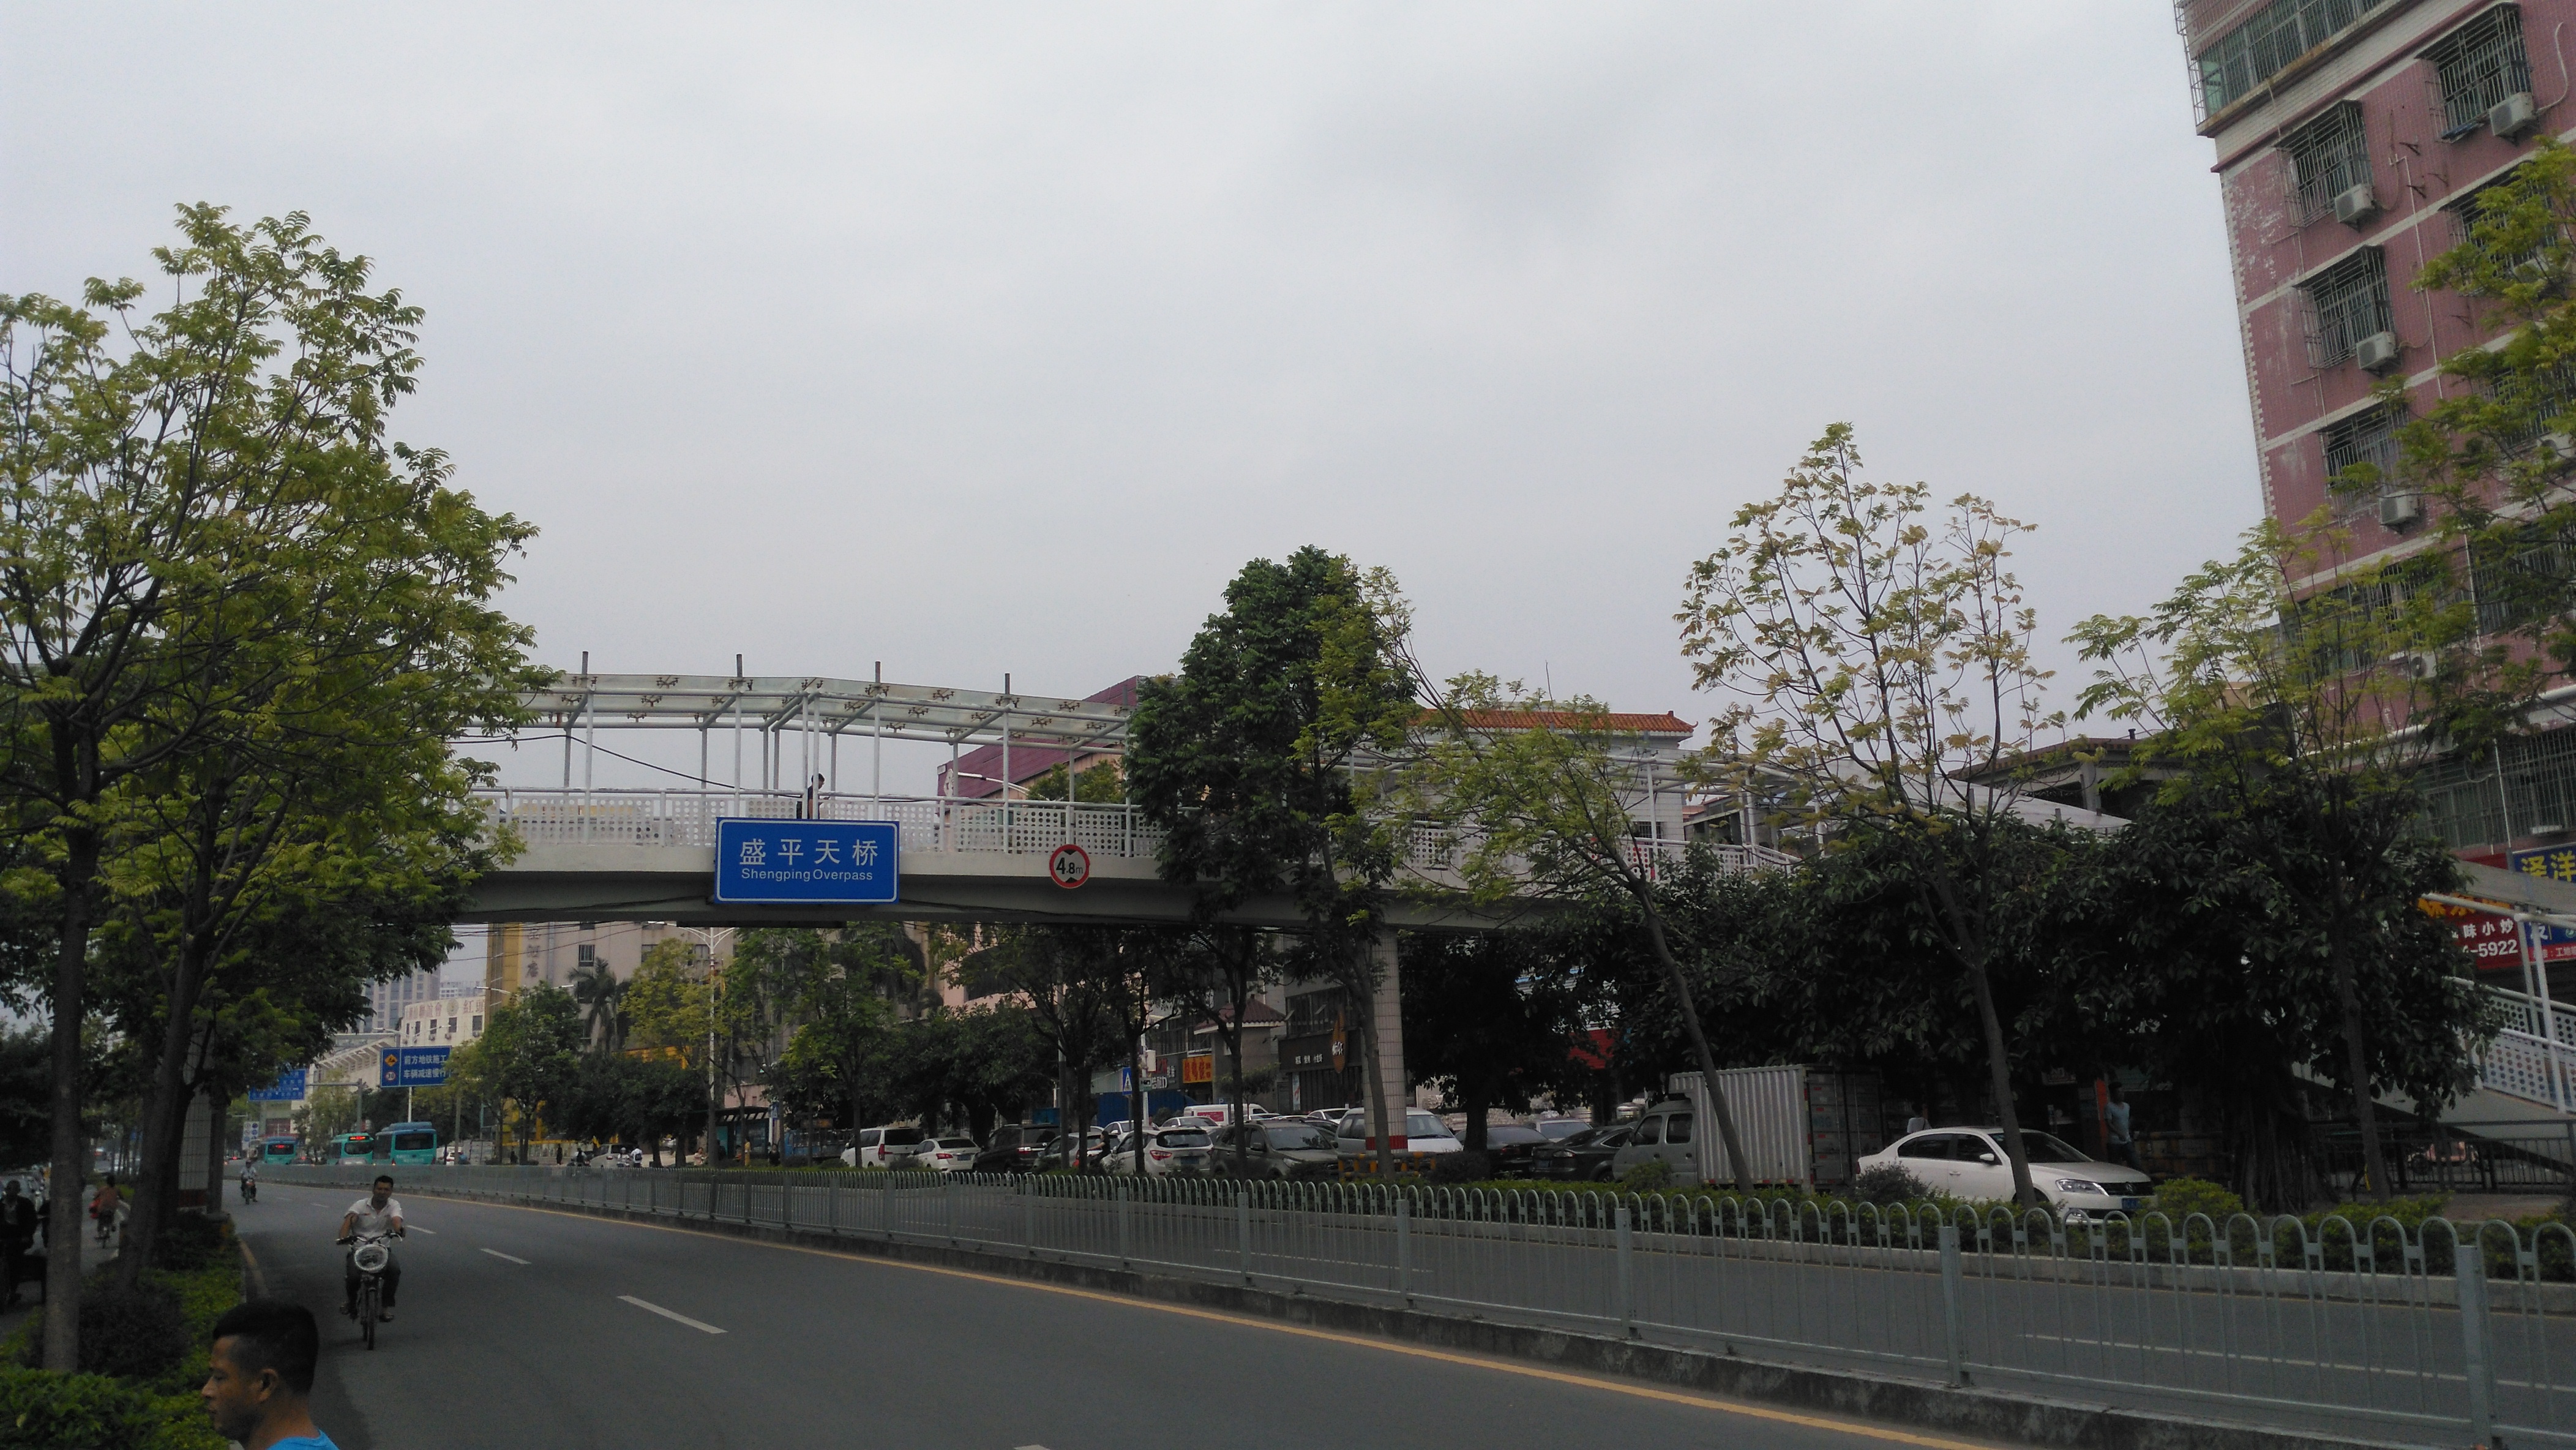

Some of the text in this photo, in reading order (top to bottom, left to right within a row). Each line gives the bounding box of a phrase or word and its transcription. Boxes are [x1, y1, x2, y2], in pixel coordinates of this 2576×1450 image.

[739, 838, 878, 866] 盛平天桥
[1056, 857, 1084, 874] 4.8m
[741, 868, 873, 882] Shengping Overpass
[2452, 918, 2514, 939] 味小炒
[404, 1054, 447, 1064] 前方地铁施工
[403, 1067, 446, 1078] 车辆减速慢行
